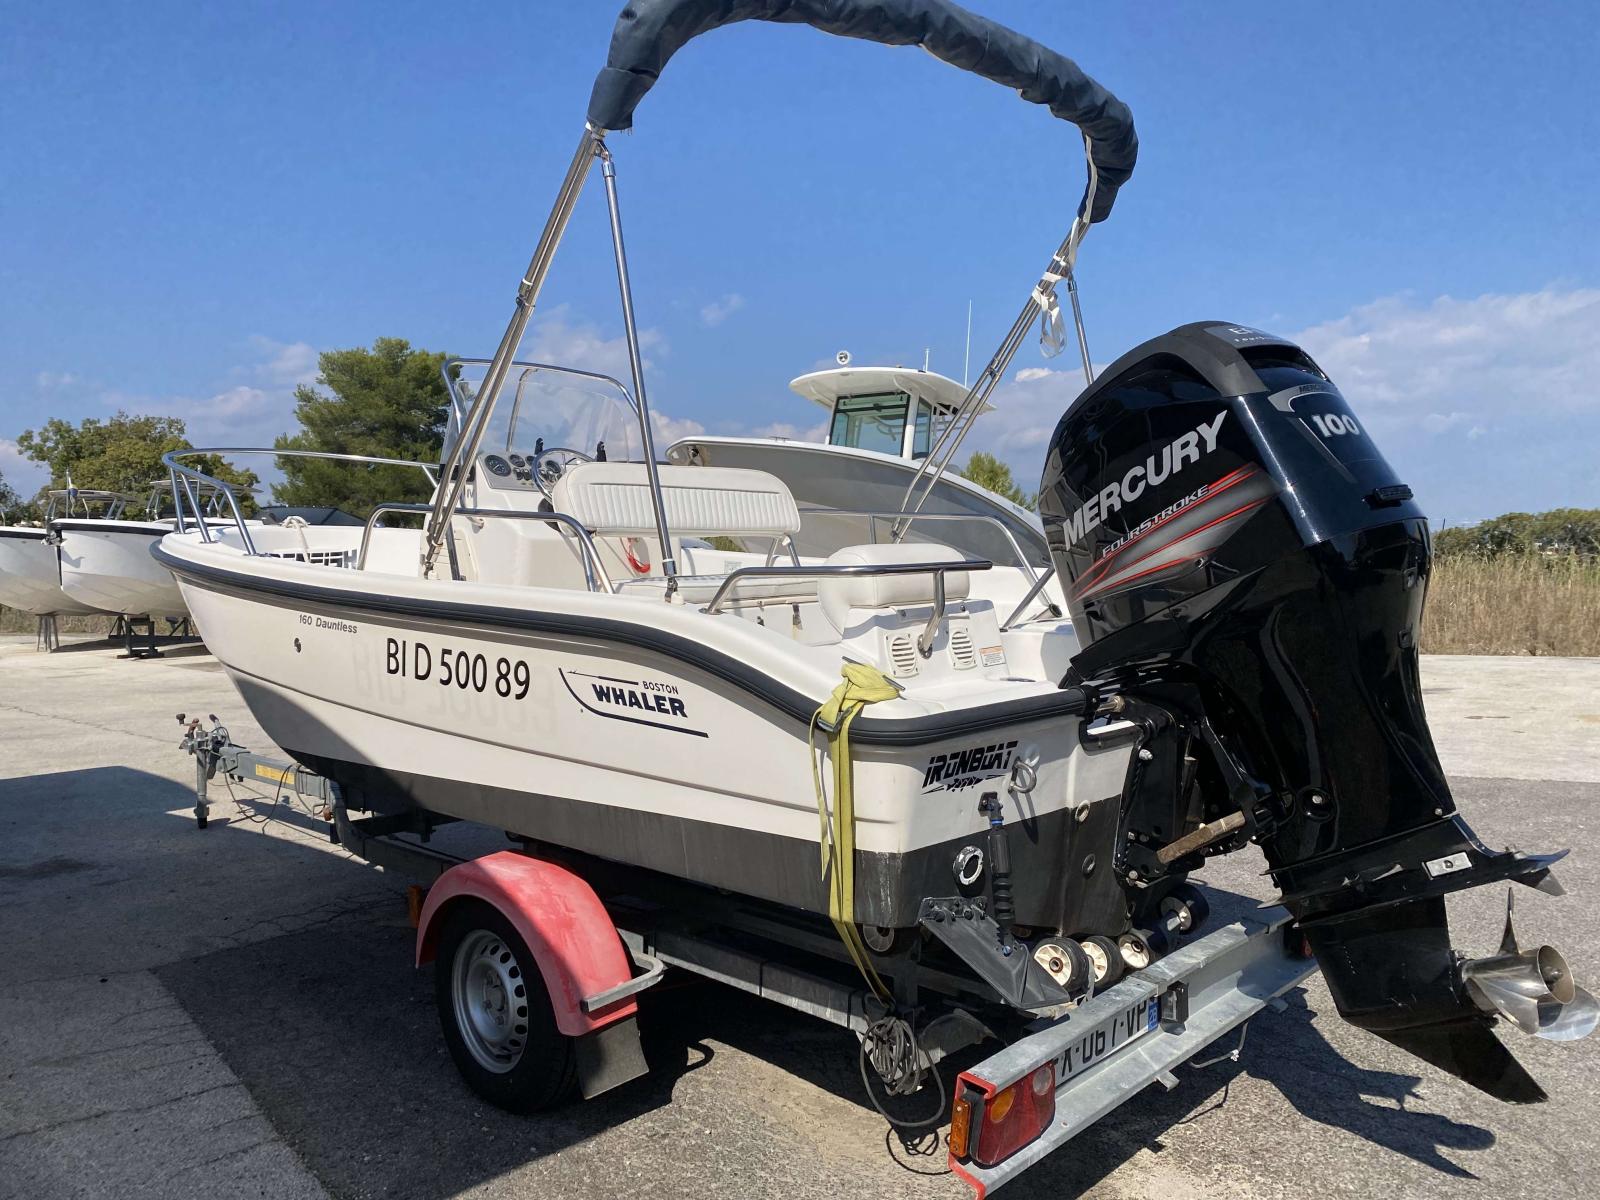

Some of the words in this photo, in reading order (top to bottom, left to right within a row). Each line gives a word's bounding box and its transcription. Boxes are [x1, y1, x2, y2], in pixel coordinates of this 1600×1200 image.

[1312, 413, 1360, 438] 100
[1062, 409, 1228, 552] MERCURY
[1102, 484, 1210, 558] FOURSTROKE
[299, 614, 313, 626] 160
[315, 617, 358, 634] Dauntless
[494, 657, 531, 700] 89
[642, 680, 679, 695] BOSTON
[591, 683, 688, 718] WHALER
[922, 740, 1019, 789] IRONBOAT
